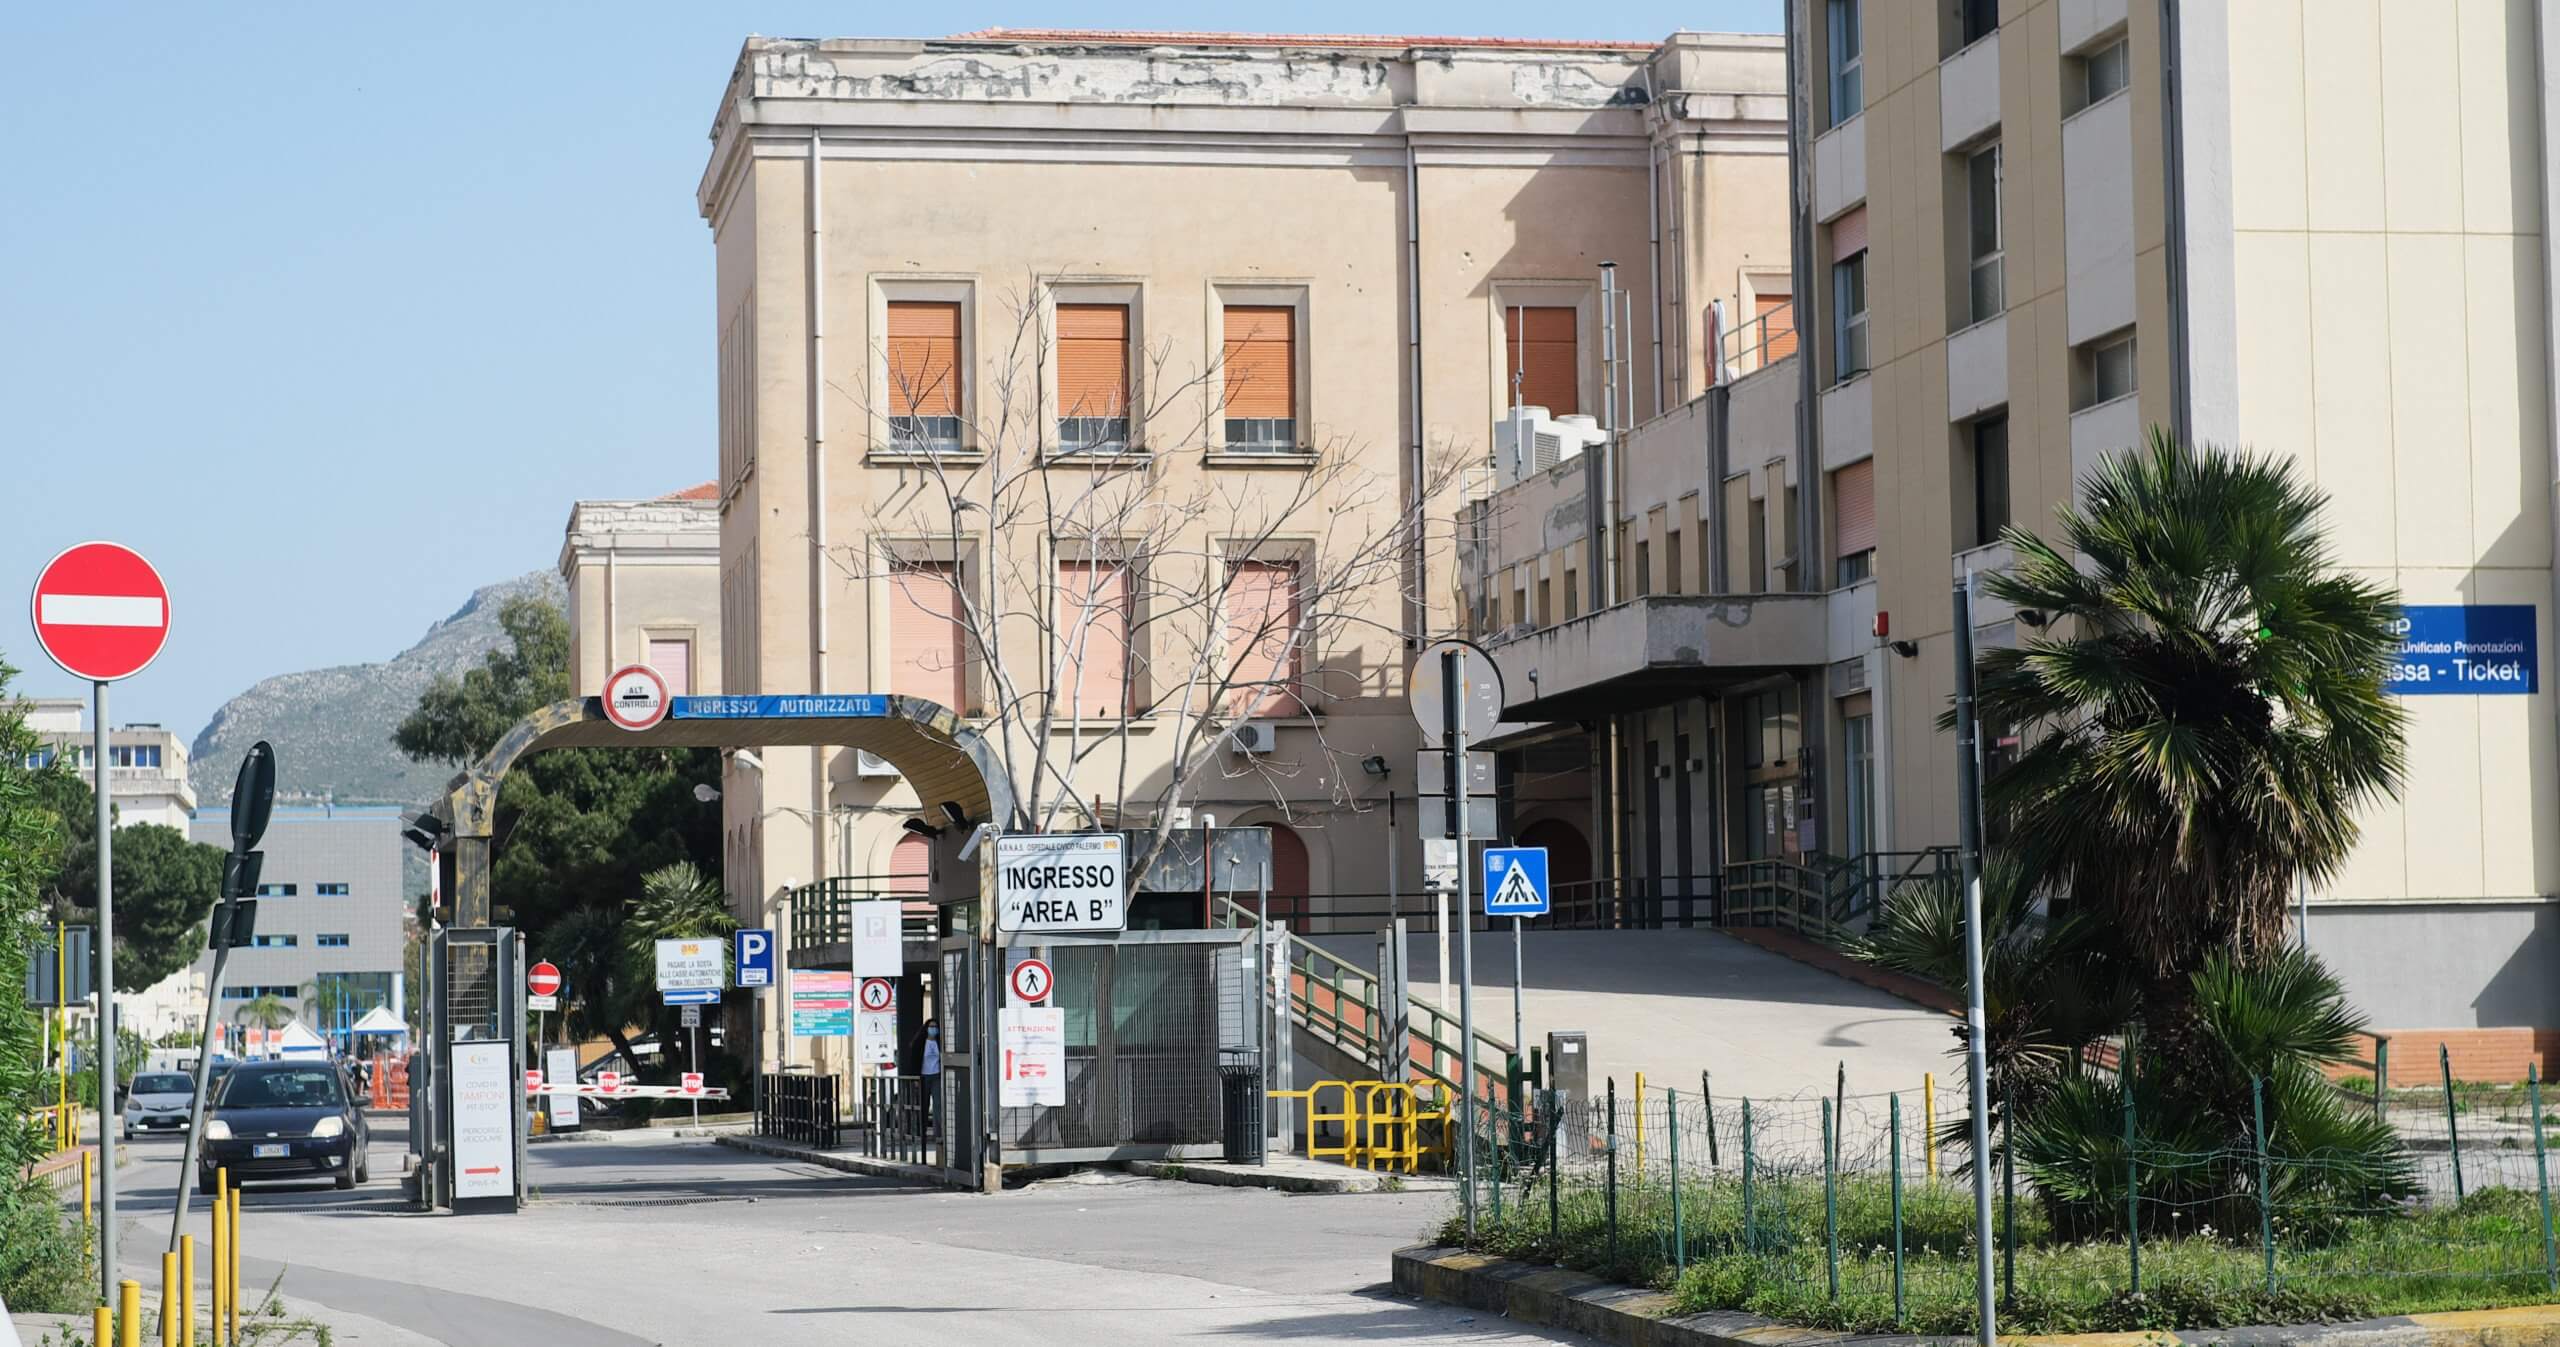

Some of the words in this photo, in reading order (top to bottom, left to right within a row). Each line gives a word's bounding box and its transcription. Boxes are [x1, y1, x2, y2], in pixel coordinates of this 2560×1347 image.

[2402, 641, 2451, 654] Unificato
[2454, 640, 2524, 654] Prenotazioni
[2452, 659, 2521, 682] Ticket
[629, 686, 643, 694] ALT
[614, 700, 658, 709] CONTROLLO
[689, 700, 757, 714] INGRESSO
[779, 699, 871, 713] AUTORIZZATO
[1027, 842, 1056, 851] OSPEDALE
[1076, 840, 1101, 850] PALERMO
[1007, 865, 1114, 890] INGRESSO
[743, 933, 767, 965] P
[667, 960, 687, 969] PAGARE
[1007, 1025, 1057, 1033] ATTENZIONE
[599, 1077, 620, 1088] STOP
[683, 1078, 703, 1089] STOP
[458, 1091, 505, 1100] TAMPONI
